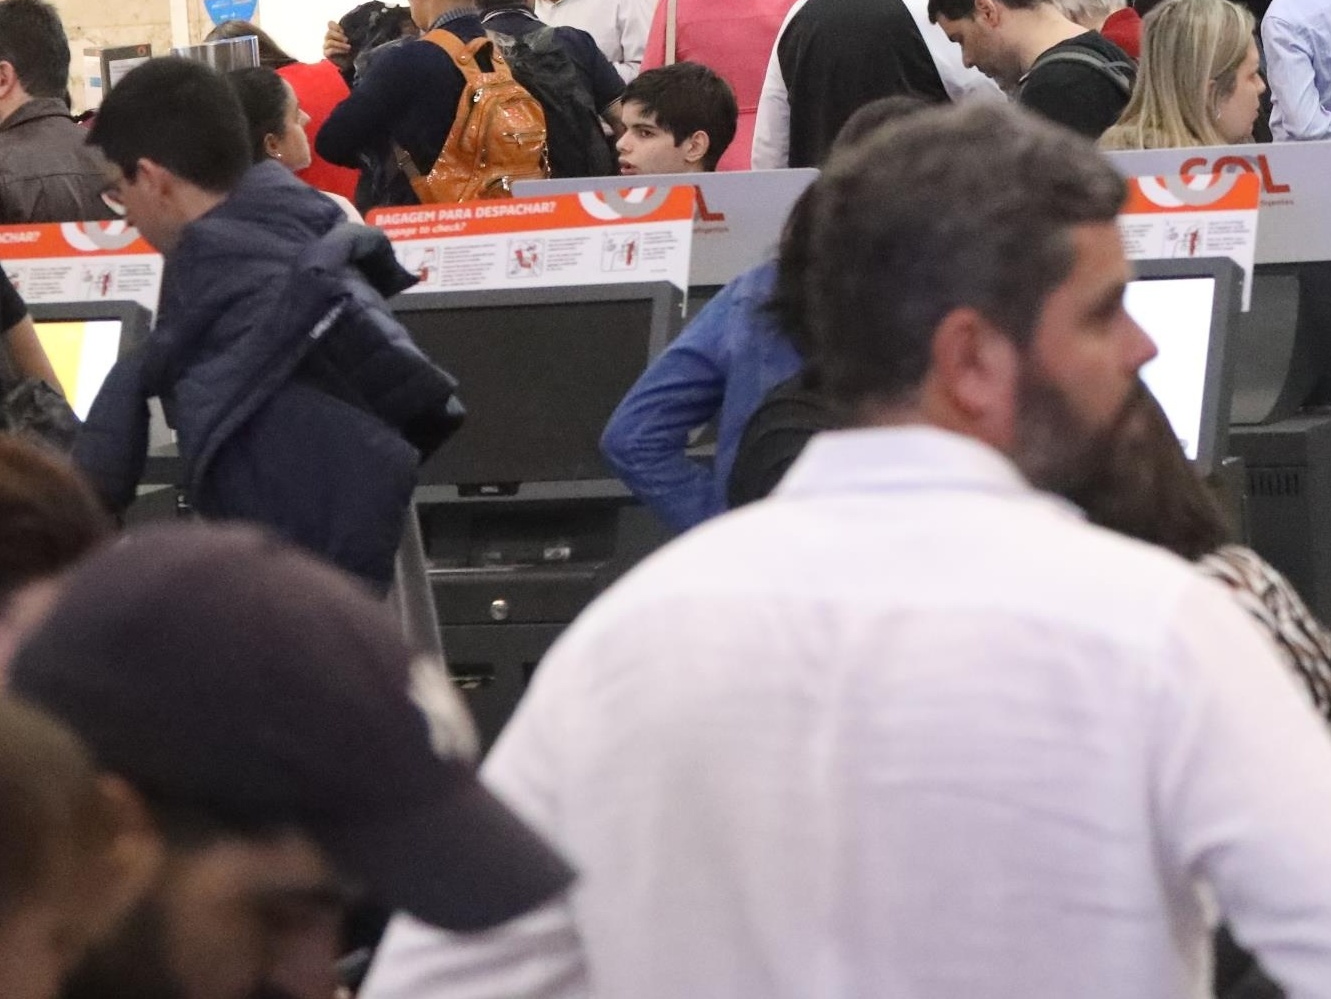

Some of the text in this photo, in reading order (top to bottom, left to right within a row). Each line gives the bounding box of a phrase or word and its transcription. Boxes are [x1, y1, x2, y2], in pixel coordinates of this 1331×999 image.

[375, 201, 557, 226] BAGAGEM PARA DESPACHAR?
